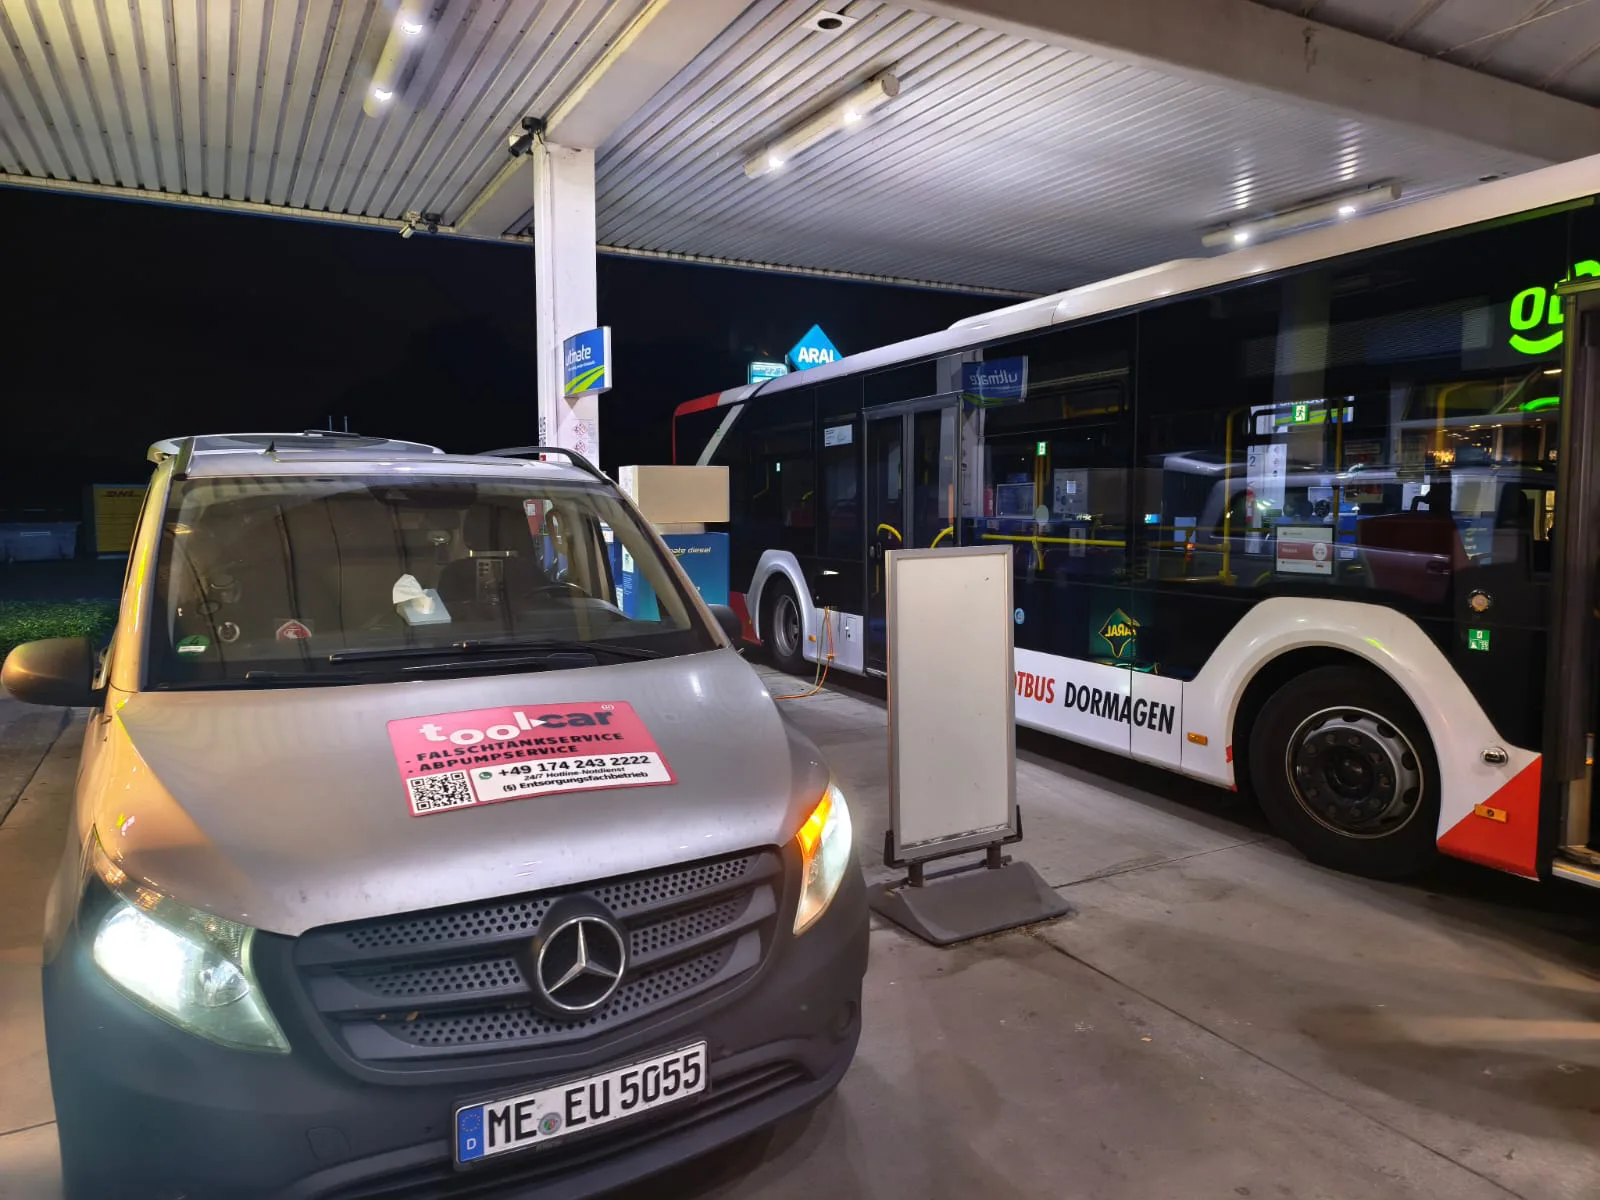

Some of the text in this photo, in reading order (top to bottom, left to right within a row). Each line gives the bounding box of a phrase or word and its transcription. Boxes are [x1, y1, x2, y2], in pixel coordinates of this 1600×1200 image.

[1014, 671, 1176, 735] TBUS DORMAGEN
[419, 711, 532, 746] tool
[540, 709, 613, 729] car
[416, 732, 625, 762] FALSCHTANKSERVICE
[420, 745, 579, 773] ABPUMPSERVICE
[498, 755, 651, 777] +49 174 243 2222
[520, 771, 649, 789] Entsorgungsfachbetrieb
[488, 1051, 701, 1148] ME EU 5055
[466, 1138, 477, 1151] D
